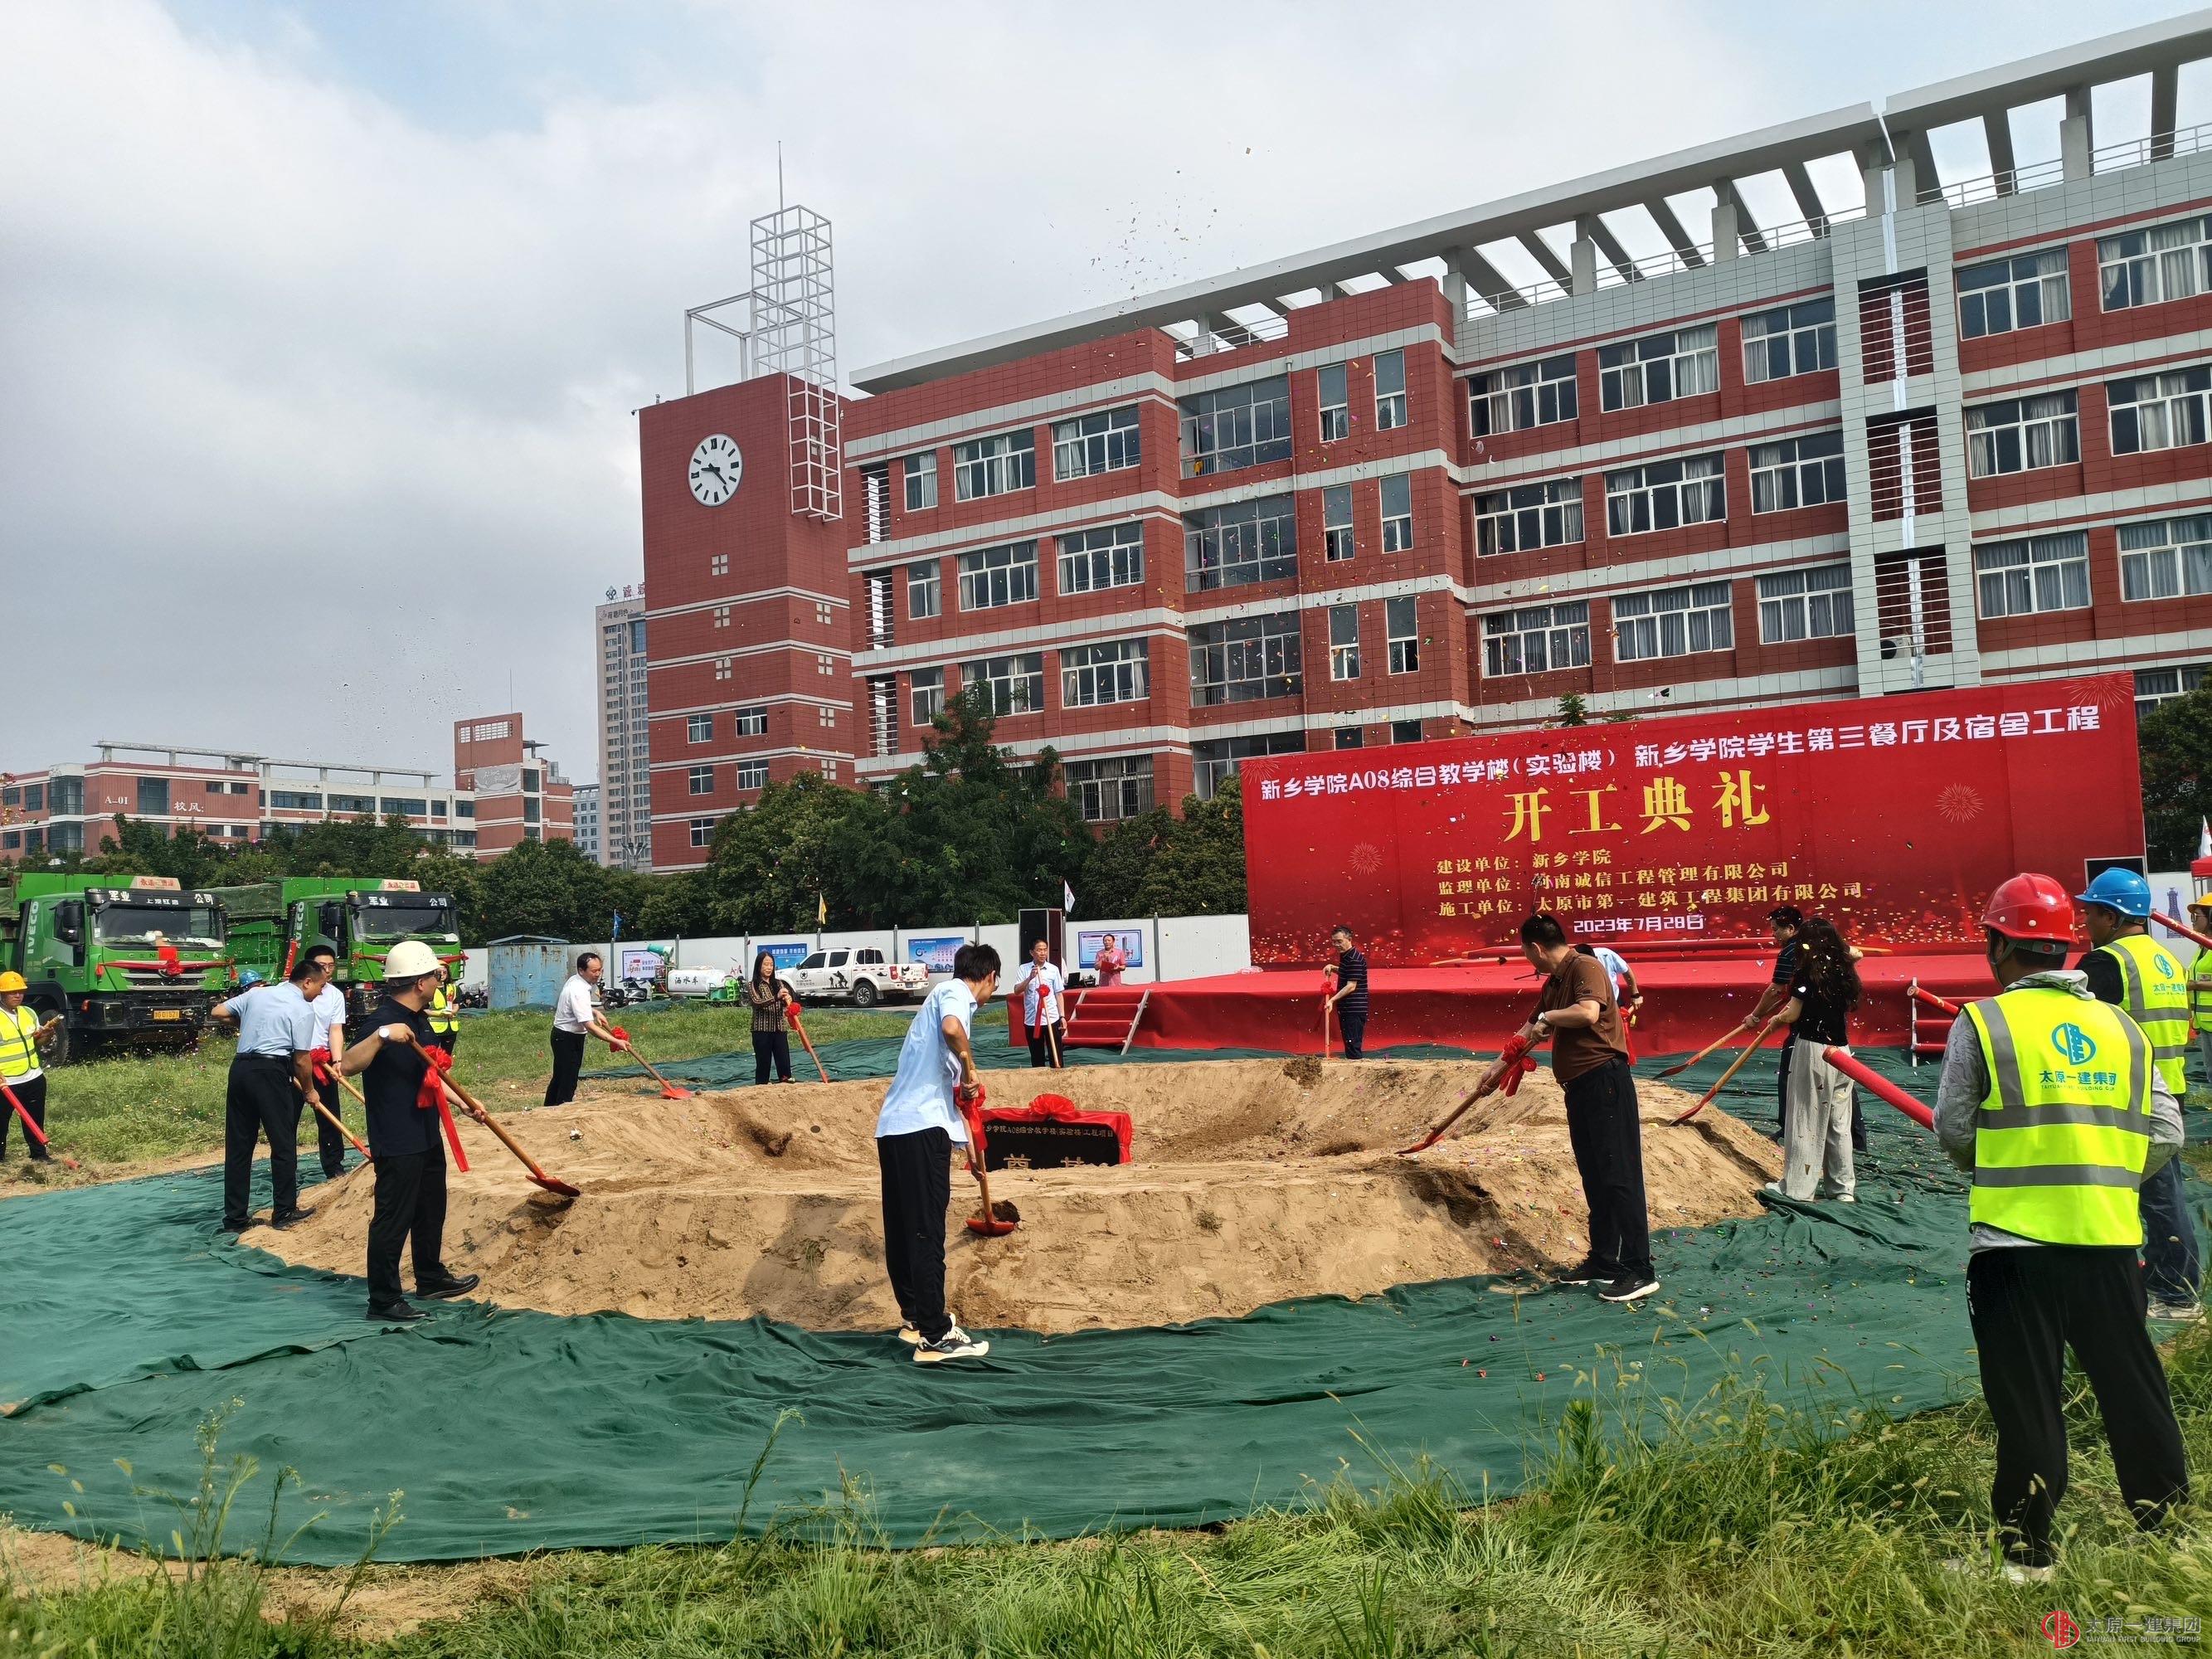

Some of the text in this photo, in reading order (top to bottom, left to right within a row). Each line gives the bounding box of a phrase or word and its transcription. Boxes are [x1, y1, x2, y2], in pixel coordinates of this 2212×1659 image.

[1635, 704, 2101, 767] 新乡学院学生第三餐厅及宿舍工程
[1502, 769, 1771, 842] 开工典礼
[1437, 849, 1612, 875] 建设单位：新乡学院
[194, 893, 213, 905] 公司
[430, 898, 447, 907] 公司
[27, 901, 39, 954] IVECO
[1573, 914, 1704, 933] 2023年7月28日
